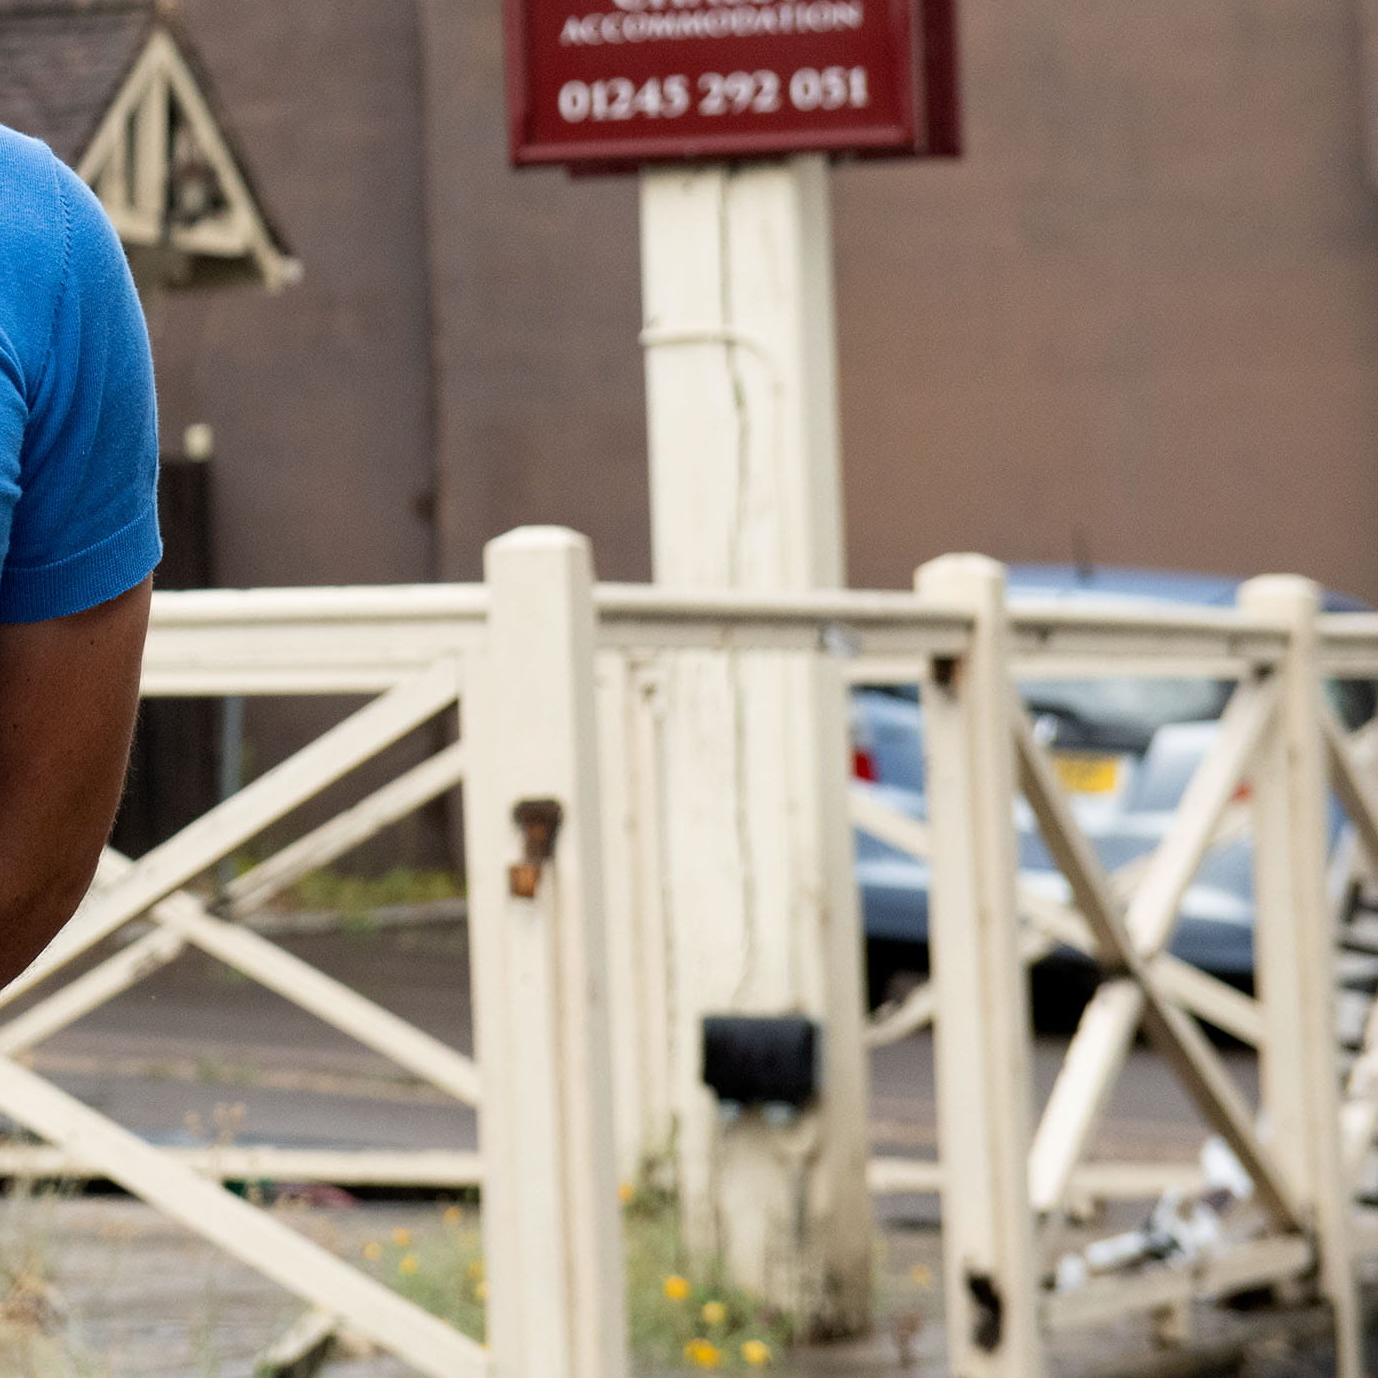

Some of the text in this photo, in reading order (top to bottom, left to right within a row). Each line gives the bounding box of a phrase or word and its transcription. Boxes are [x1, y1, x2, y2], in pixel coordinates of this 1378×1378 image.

[558, 65, 868, 123] 01245 292 051
